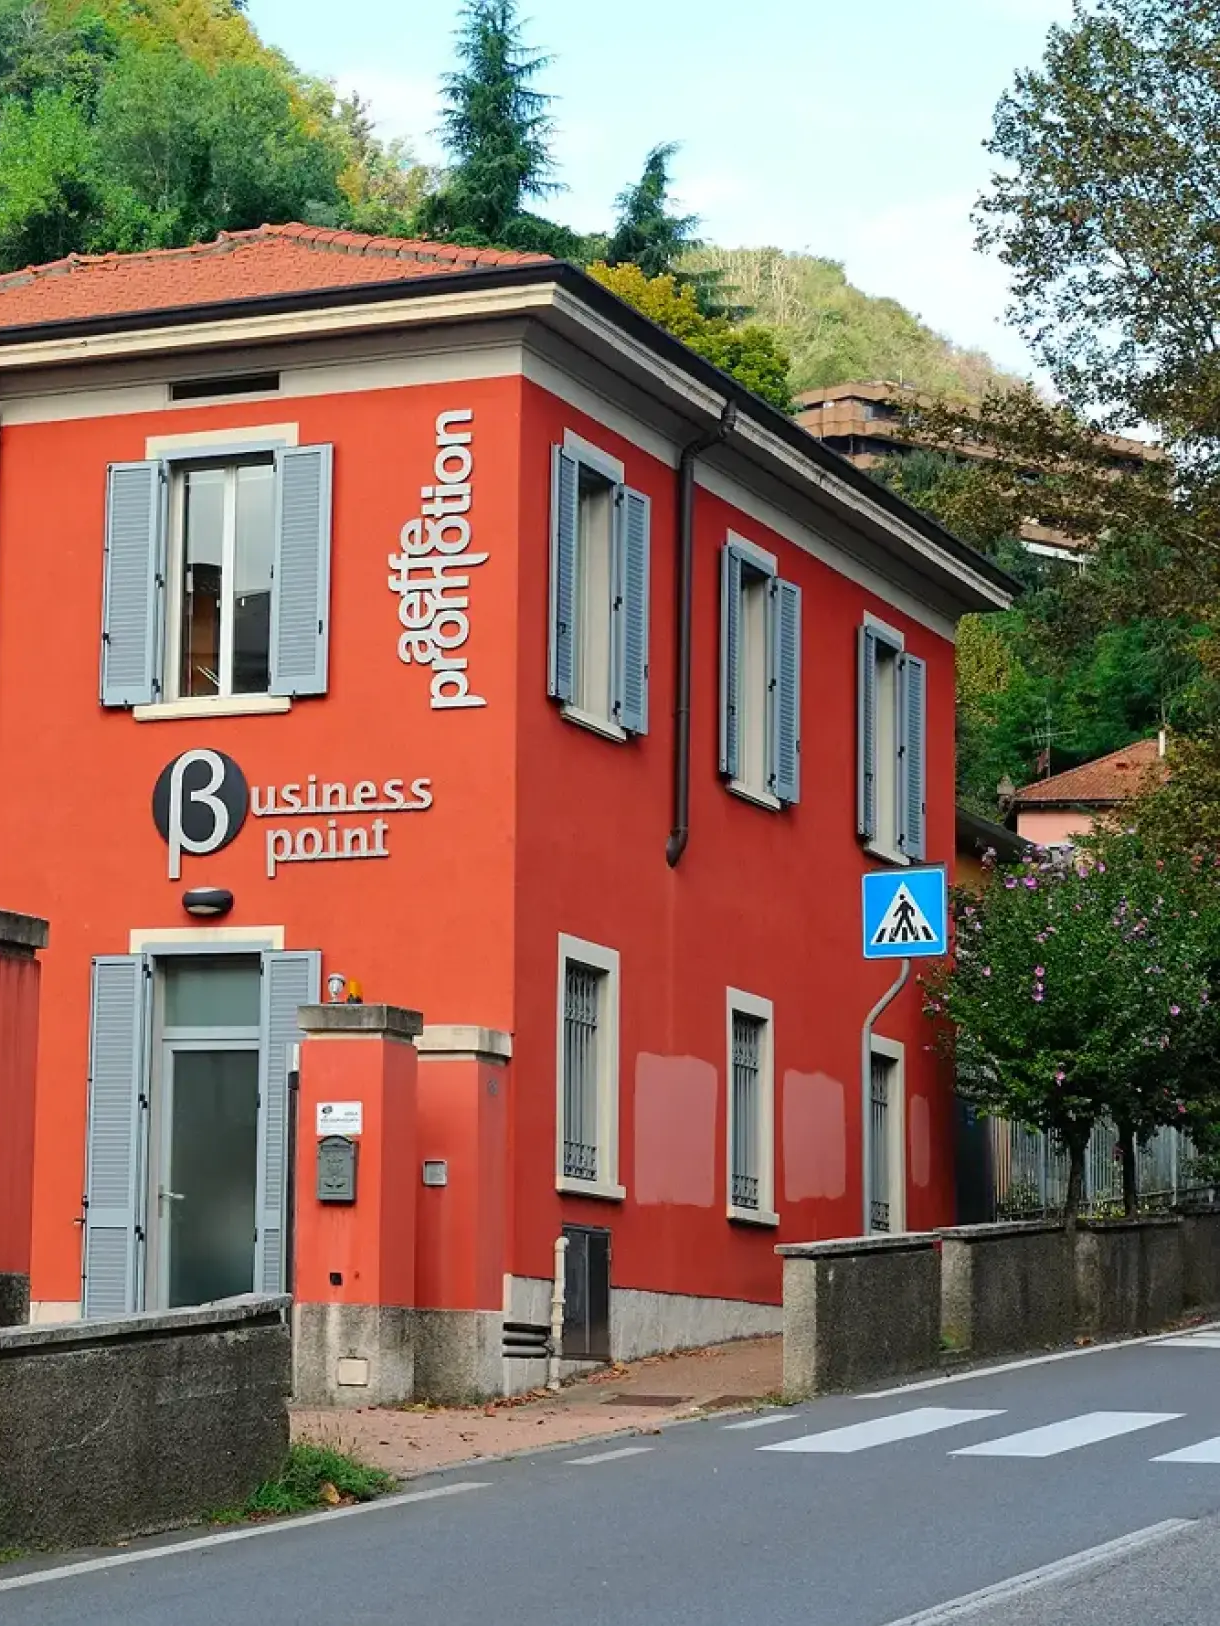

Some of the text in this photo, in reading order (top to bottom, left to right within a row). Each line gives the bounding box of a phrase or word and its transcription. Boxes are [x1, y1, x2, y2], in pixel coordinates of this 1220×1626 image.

[388, 517, 436, 665] aeffe
[421, 408, 490, 709] promotion
[267, 819, 389, 877] point
